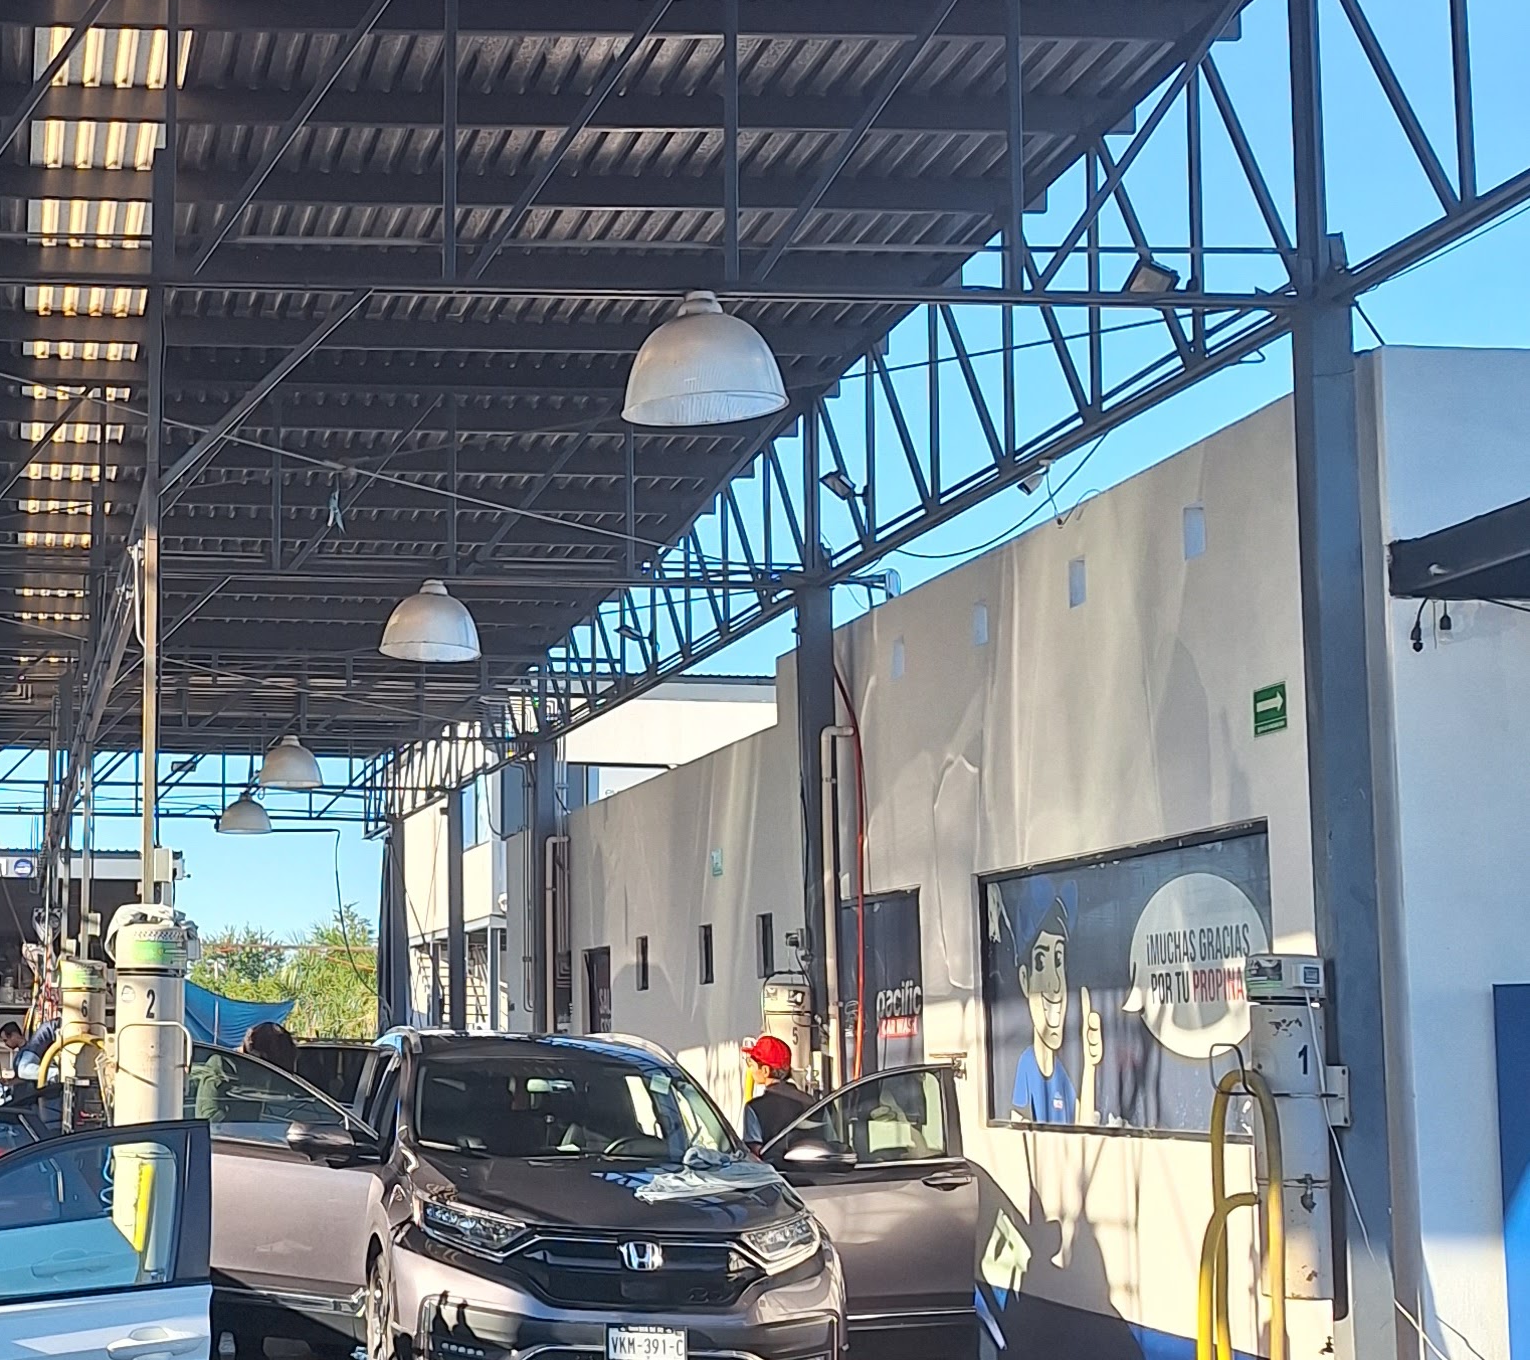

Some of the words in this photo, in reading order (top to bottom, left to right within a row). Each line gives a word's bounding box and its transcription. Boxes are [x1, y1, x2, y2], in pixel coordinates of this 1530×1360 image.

[1199, 923, 1250, 961] GRACIAS
[876, 980, 921, 1022] pacific
[1151, 971, 1173, 1005] POR
[1175, 969, 1190, 1004] TU
[1192, 967, 1245, 1003] PROPINA
[81, 1000, 88, 1018] 6
[145, 989, 156, 1019] 2
[792, 1027, 799, 1044] 5
[1297, 1044, 1308, 1075] 1
[611, 1336, 683, 1357] VKM-391-C
